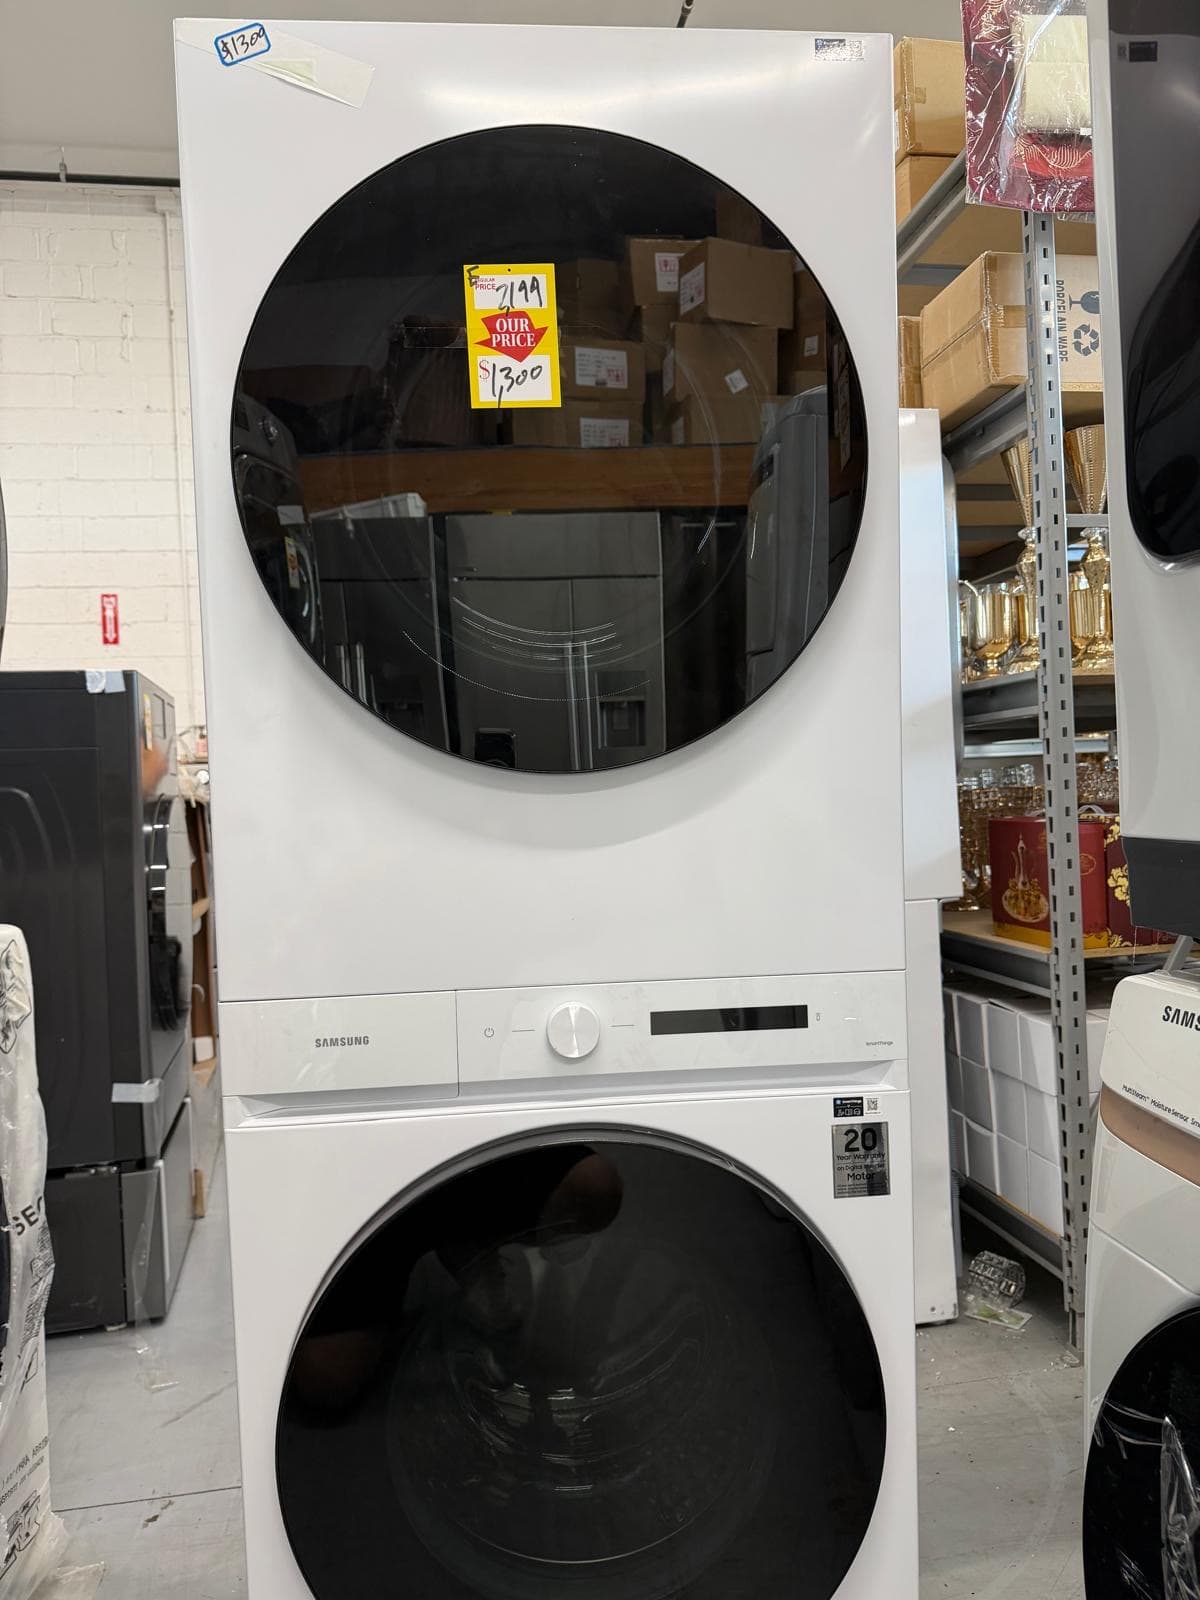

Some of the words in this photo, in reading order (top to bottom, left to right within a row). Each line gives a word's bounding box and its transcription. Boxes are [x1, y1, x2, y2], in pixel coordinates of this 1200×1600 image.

[221, 27, 265, 60] $1300
[496, 318, 530, 332] OUR
[491, 333, 536, 347] PRICE
[315, 1035, 369, 1048] SAMSUNG
[844, 1128, 877, 1152] 20
[847, 1172, 876, 1181] Motor
